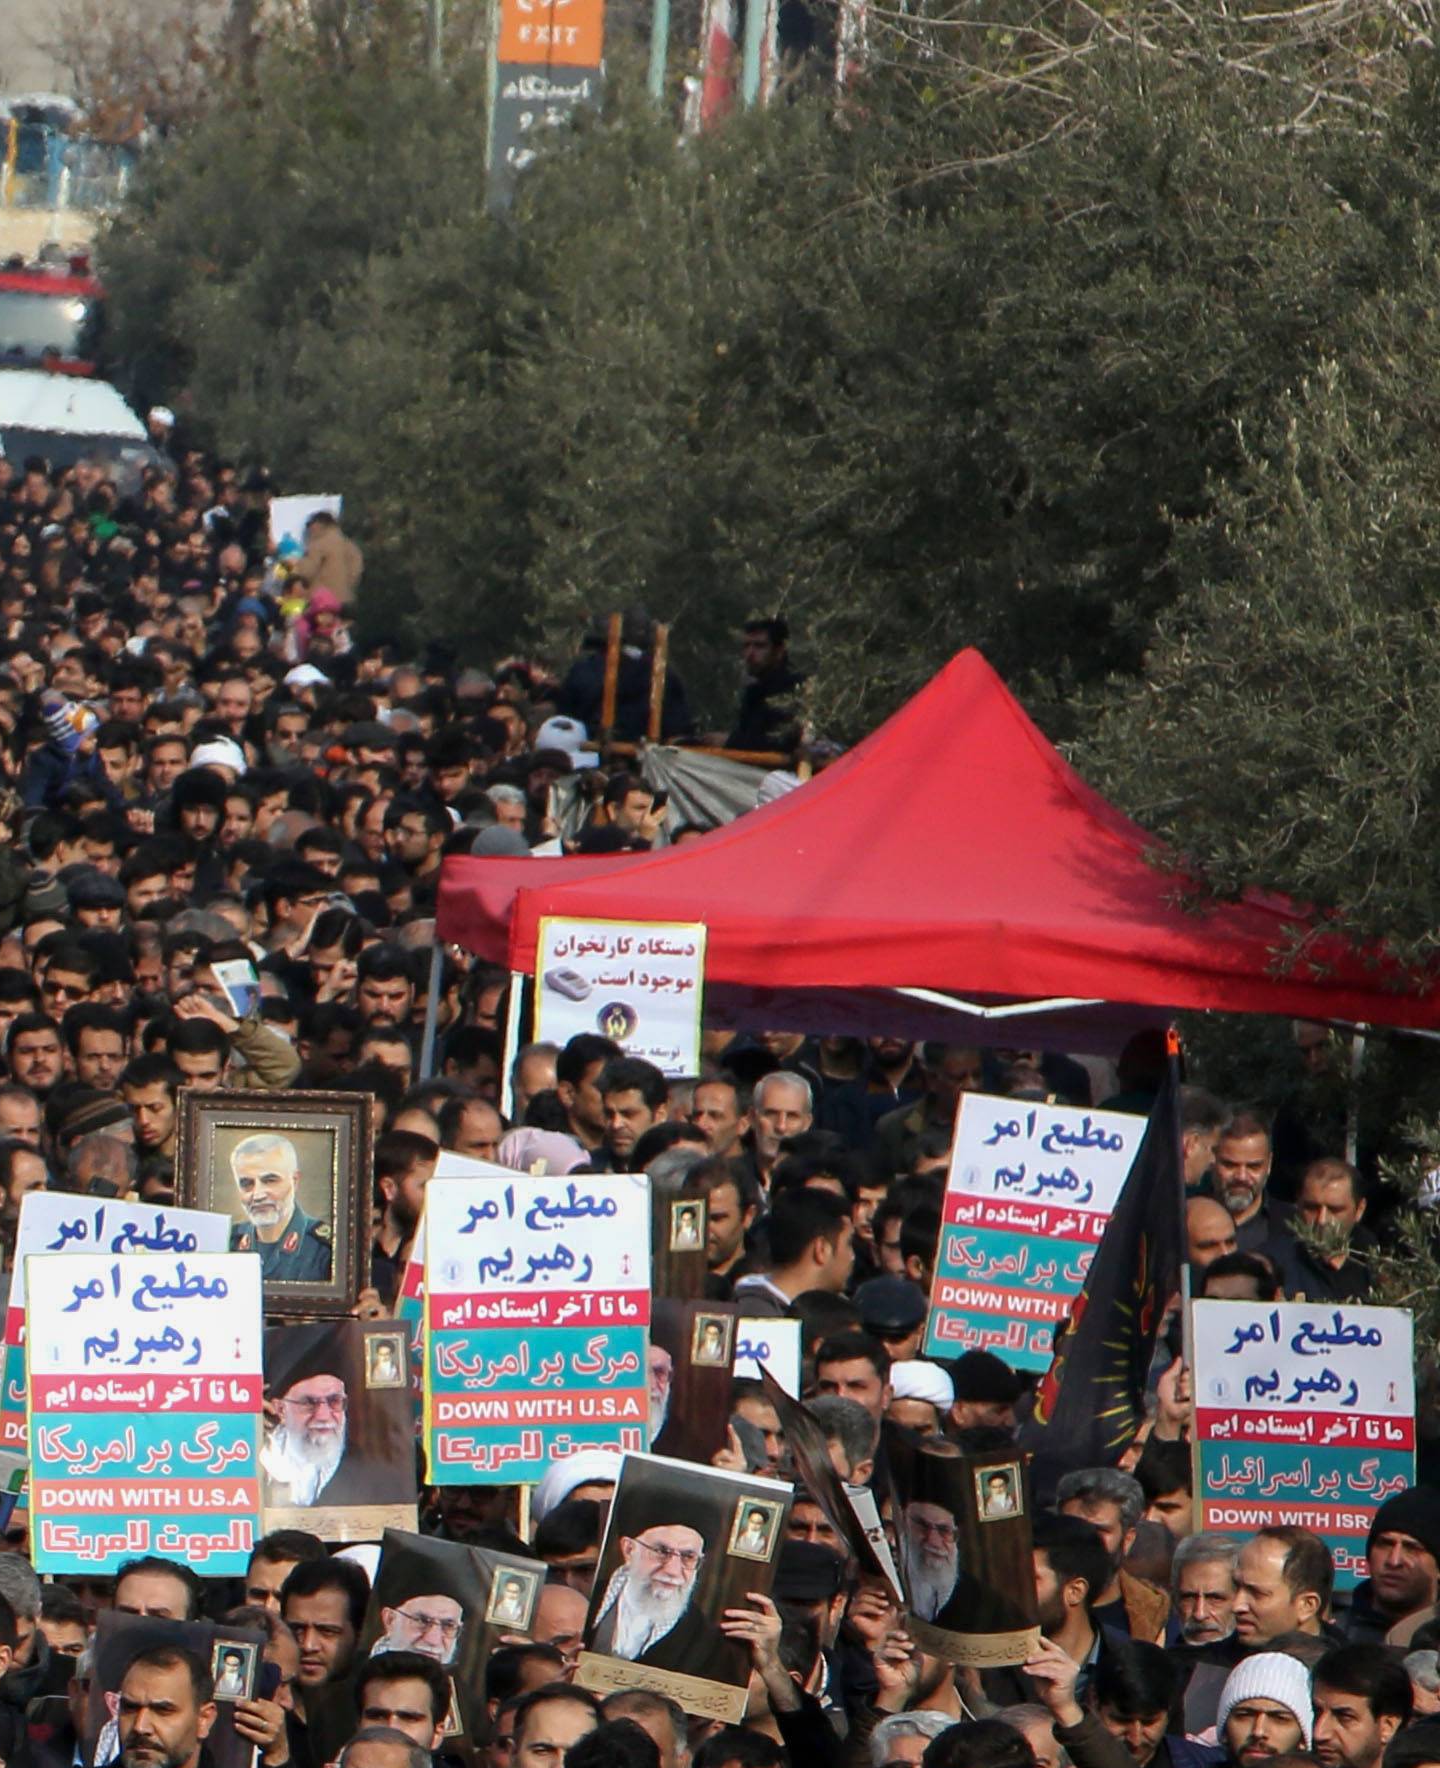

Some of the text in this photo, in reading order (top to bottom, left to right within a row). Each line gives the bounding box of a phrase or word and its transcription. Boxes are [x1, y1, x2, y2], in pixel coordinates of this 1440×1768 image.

[517, 25, 578, 45] EXIT
[554, 935, 695, 958] دستگاه کارتخوان
[592, 970, 693, 994] موجود است.
[983, 1110, 1124, 1155] مطیع امر
[994, 1162, 1094, 1203] رهبریم
[458, 1183, 618, 1233] مطیع امر
[478, 1243, 593, 1284] رهبریم
[62, 1261, 228, 1312] مطیع امر
[83, 1324, 202, 1366] رهبریم
[1224, 1309, 1383, 1355] مطیع امر
[1244, 1368, 1359, 1406] رهبریم
[438, 1397, 639, 1421] DOWN WITH U.S.A
[41, 1488, 250, 1508] DOWN WITH U.S.A
[1207, 1455, 1408, 1501] مرگ بر اسرائیل
